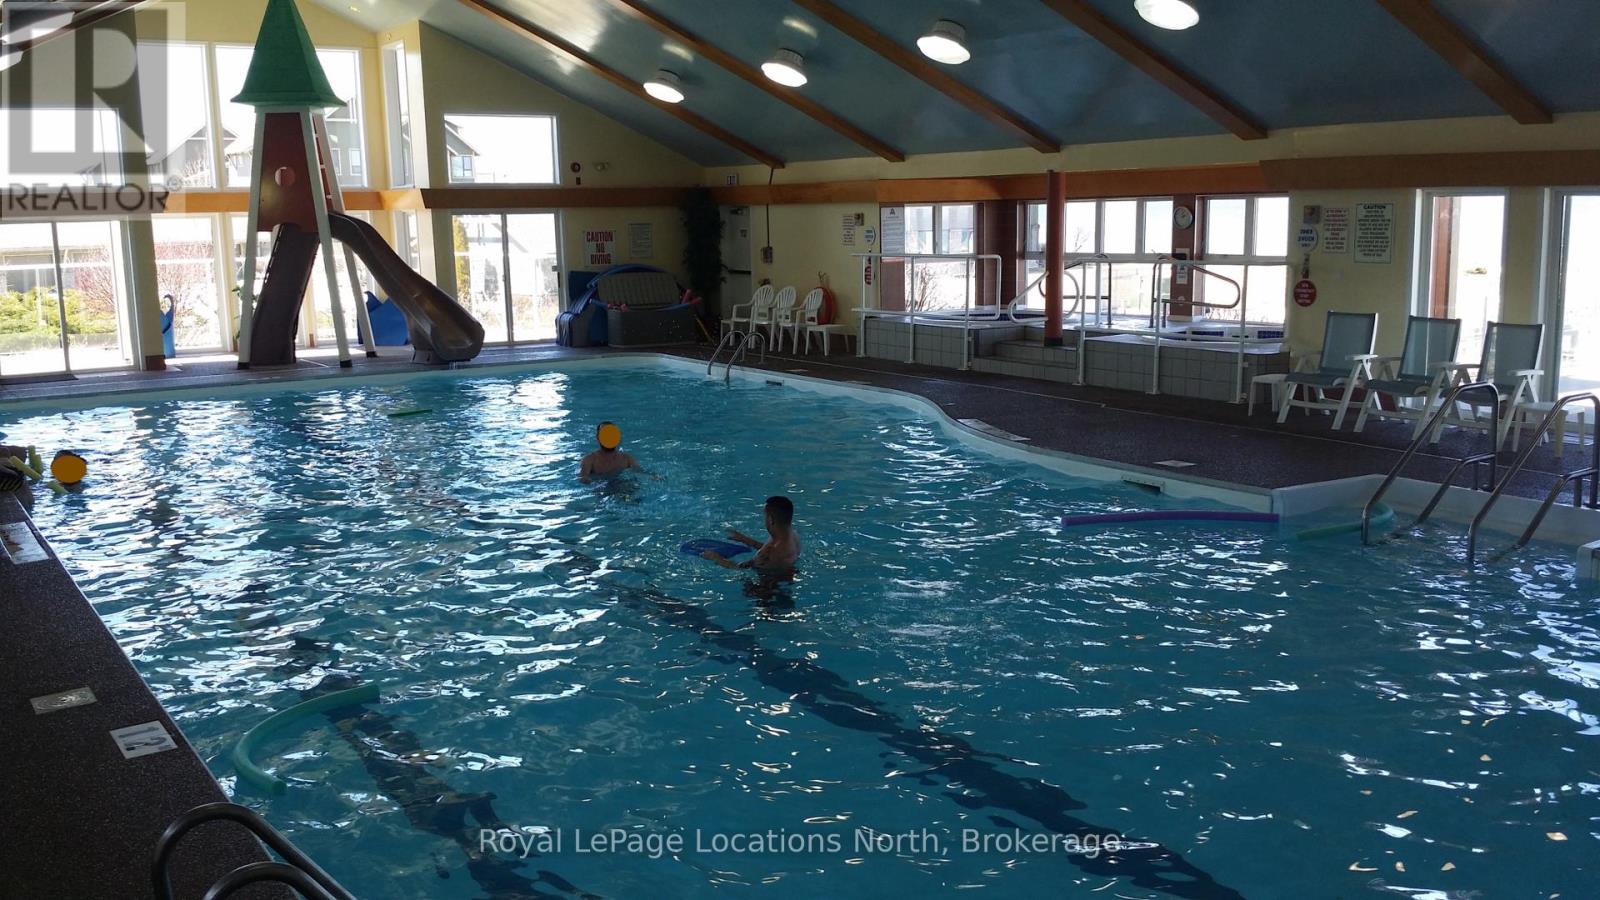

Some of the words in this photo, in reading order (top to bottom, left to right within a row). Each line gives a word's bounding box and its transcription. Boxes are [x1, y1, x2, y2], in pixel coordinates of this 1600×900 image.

[586, 231, 613, 242] CAUTION
[595, 243, 605, 253] NO
[591, 253, 612, 265] DIVING
